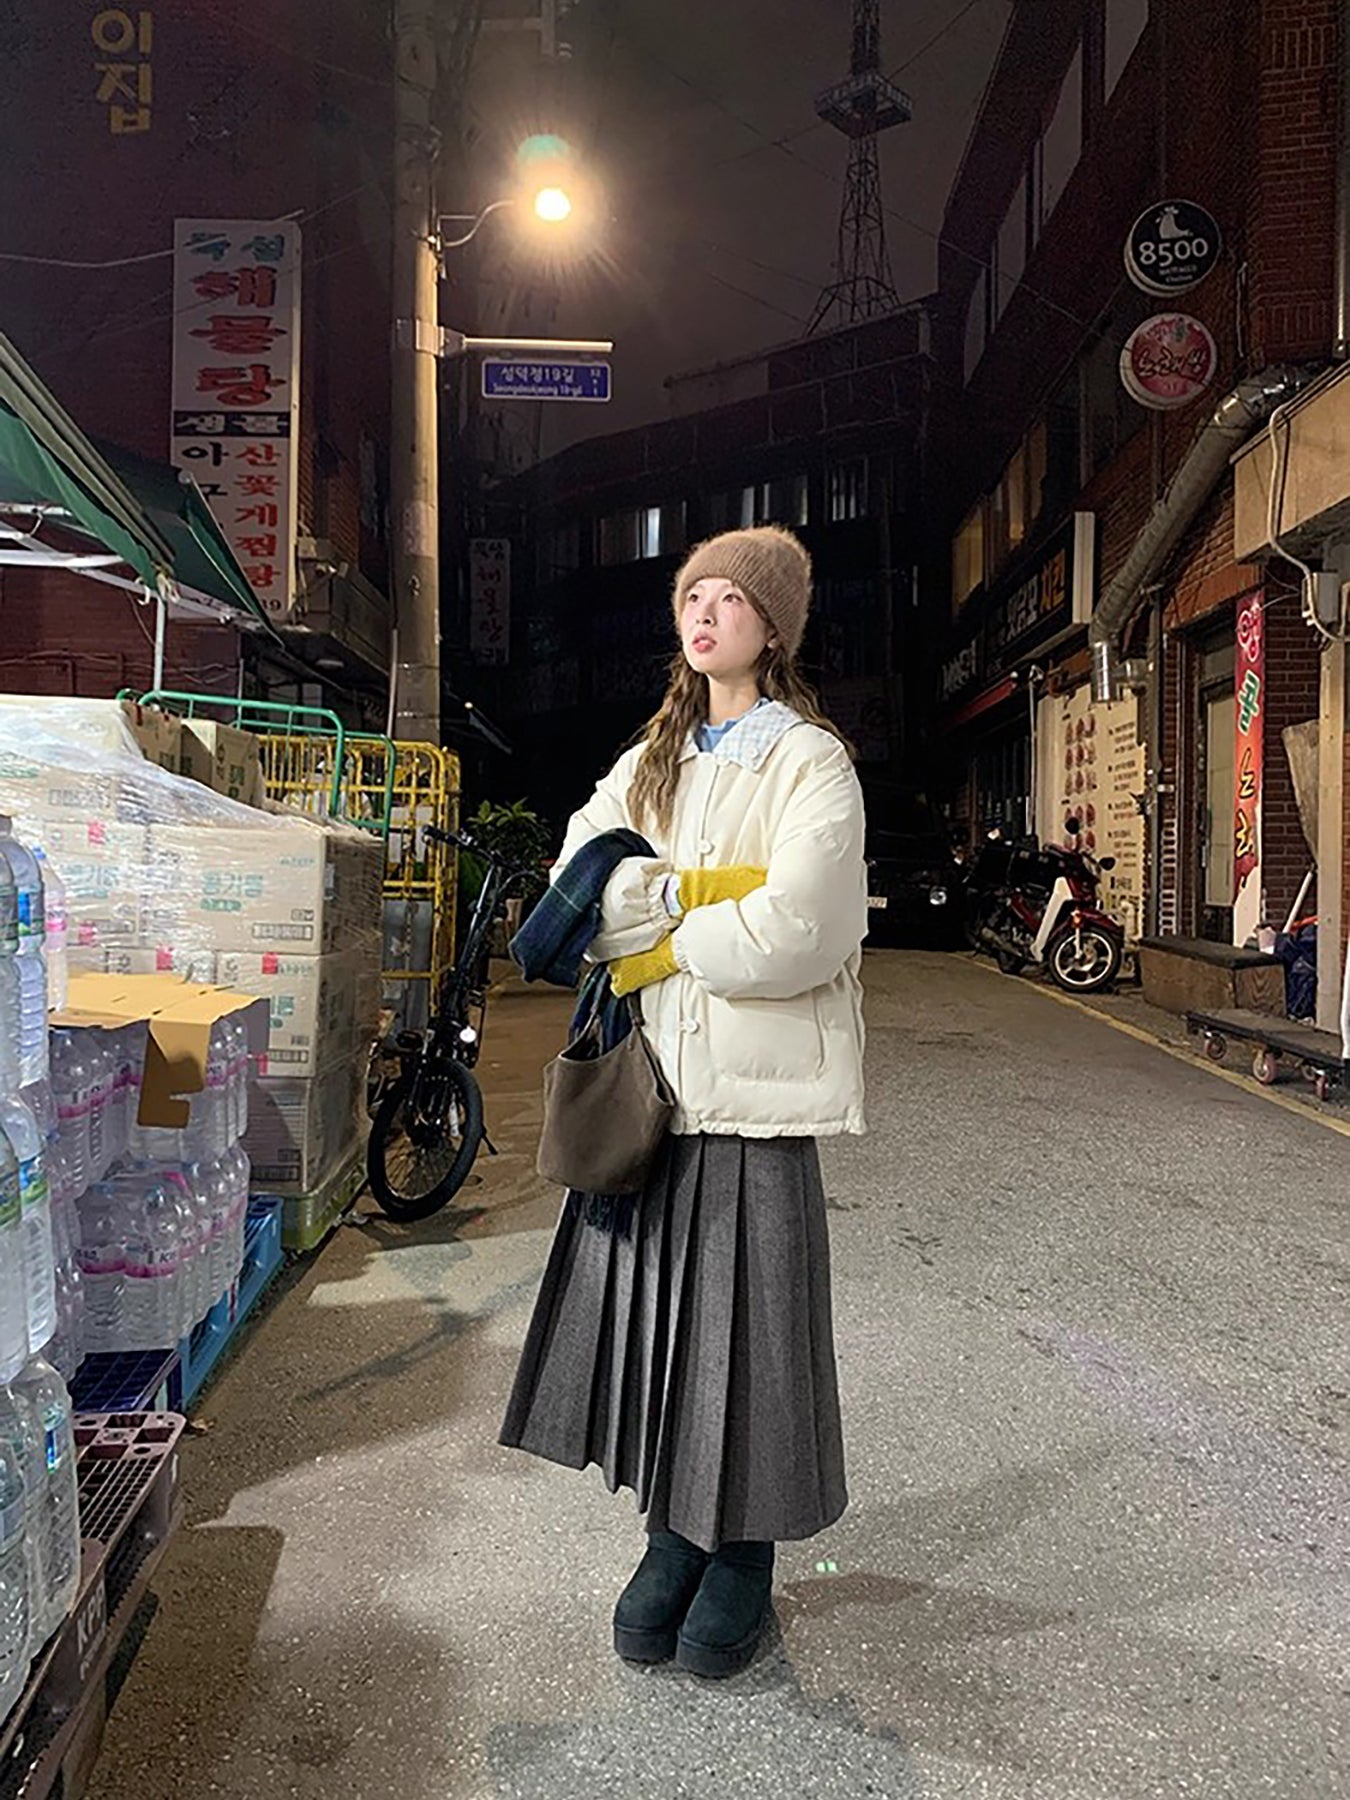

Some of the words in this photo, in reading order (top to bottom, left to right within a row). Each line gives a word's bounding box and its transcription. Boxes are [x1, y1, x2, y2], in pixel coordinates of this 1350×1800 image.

[1139, 238, 1208, 267] 8500
[188, 266, 287, 407] 해물탕
[501, 366, 574, 383] 성덕정19길
